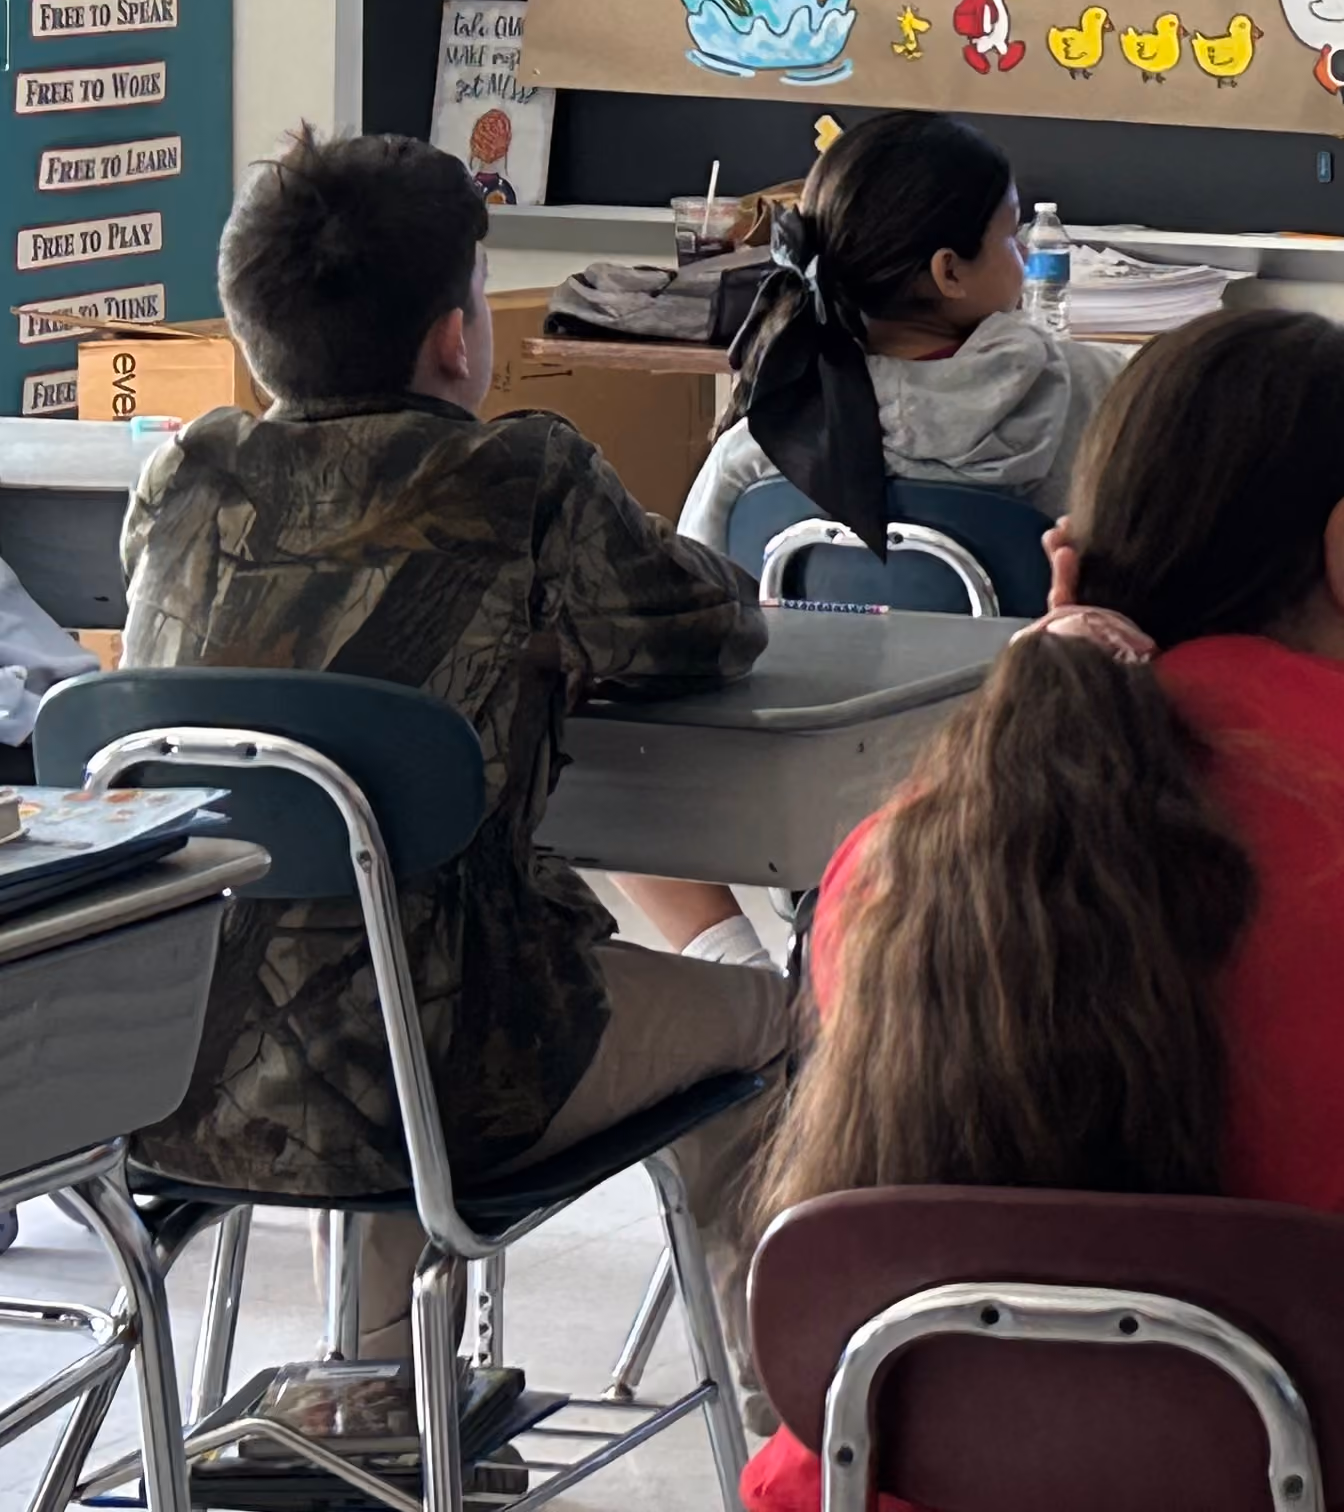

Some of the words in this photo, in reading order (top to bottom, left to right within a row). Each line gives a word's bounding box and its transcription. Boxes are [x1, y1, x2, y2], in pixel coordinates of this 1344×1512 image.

[40, 3, 85, 31] FREE
[25, 79, 74, 107] FREE
[112, 72, 161, 98] WORK
[45, 157, 96, 184] FREE
[125, 146, 177, 175] LEARN
[32, 234, 75, 261] FREE
[108, 223, 153, 250] PLAY
